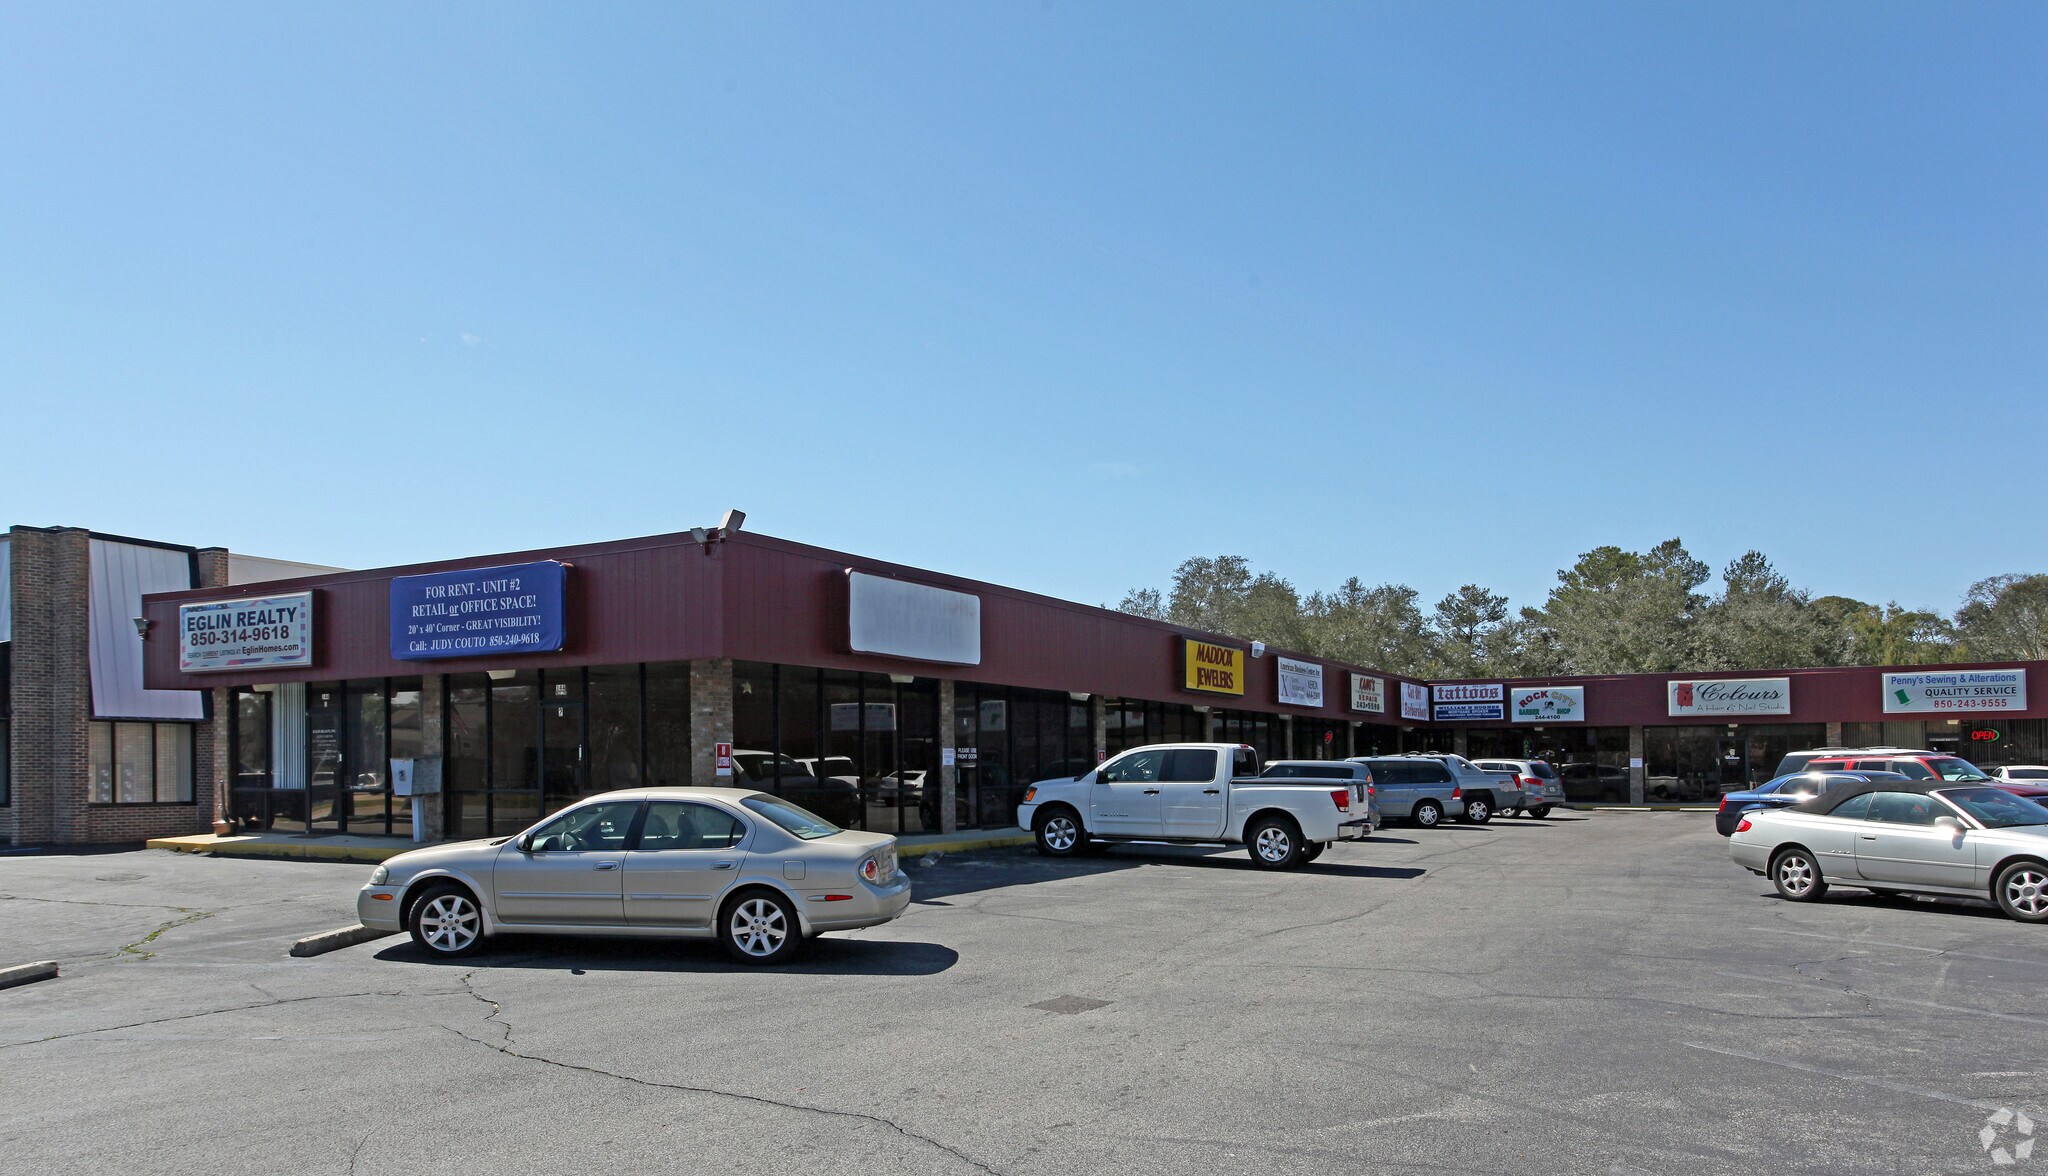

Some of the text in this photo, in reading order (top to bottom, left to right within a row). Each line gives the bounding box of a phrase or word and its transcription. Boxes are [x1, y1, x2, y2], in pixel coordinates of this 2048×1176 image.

[426, 586, 446, 598] FOR
[448, 582, 475, 597] RENT
[483, 579, 508, 594] UNIT
[509, 578, 521, 591] #2
[412, 594, 537, 618] RETAIL or OFFICE SPACE!
[187, 607, 297, 632] EGLIN REALTY
[436, 622, 460, 633] Corner
[465, 618, 493, 631] GREAT
[494, 615, 541, 629] VISIBILITY!
[191, 625, 289, 646] 850-314-9618
[409, 632, 540, 652] Call: JUDY COUTO 850-240-9618
[202, 651, 219, 659] CURRENT
[242, 643, 299, 656] EglinHomes.com
[1196, 643, 1233, 667] MADDOX
[1197, 667, 1233, 689] JEWELERS
[1891, 673, 2017, 687] Penny's Sewing & Alterations
[1359, 694, 1378, 702] REPAIR
[1437, 686, 1498, 700] tattoos
[1519, 690, 1577, 708] ROCK CITY
[1696, 682, 1783, 701] Colours
[1925, 686, 2017, 697] QUALITY SERVICE
[1706, 703, 1725, 711] Hair
[1738, 702, 1757, 711] Nail
[1758, 702, 1786, 711] Studio
[1933, 698, 2008, 709] 850-243-9555
[1972, 731, 1996, 740] OPEN
